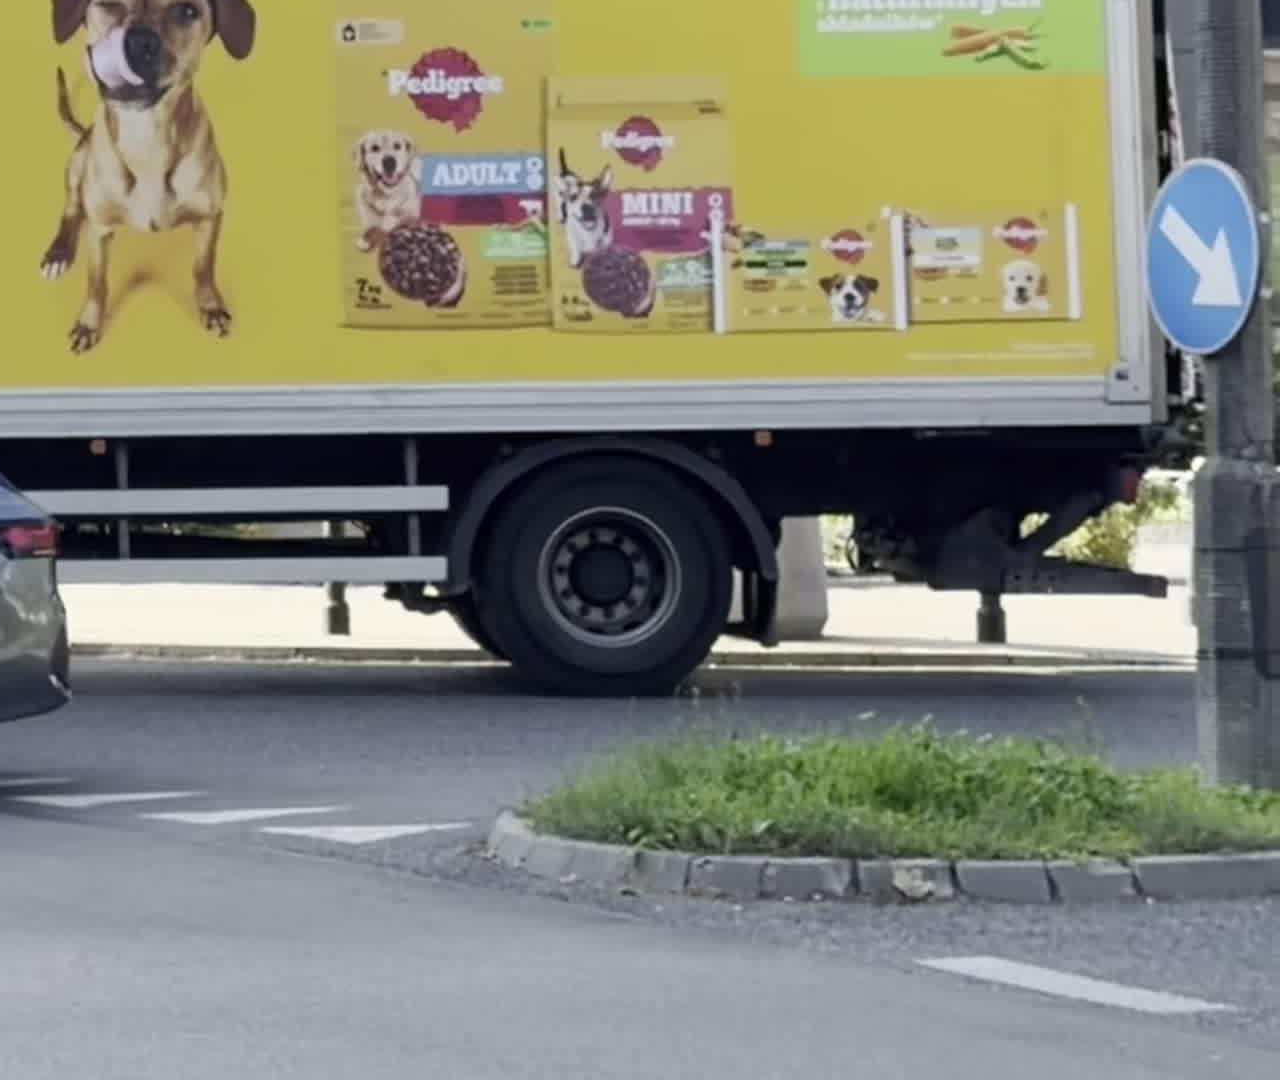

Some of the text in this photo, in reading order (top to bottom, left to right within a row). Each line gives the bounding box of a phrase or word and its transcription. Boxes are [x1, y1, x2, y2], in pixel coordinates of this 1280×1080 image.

[388, 69, 503, 100] Pedigree
[432, 161, 523, 187] ADULT
[621, 192, 694, 216] MINI
